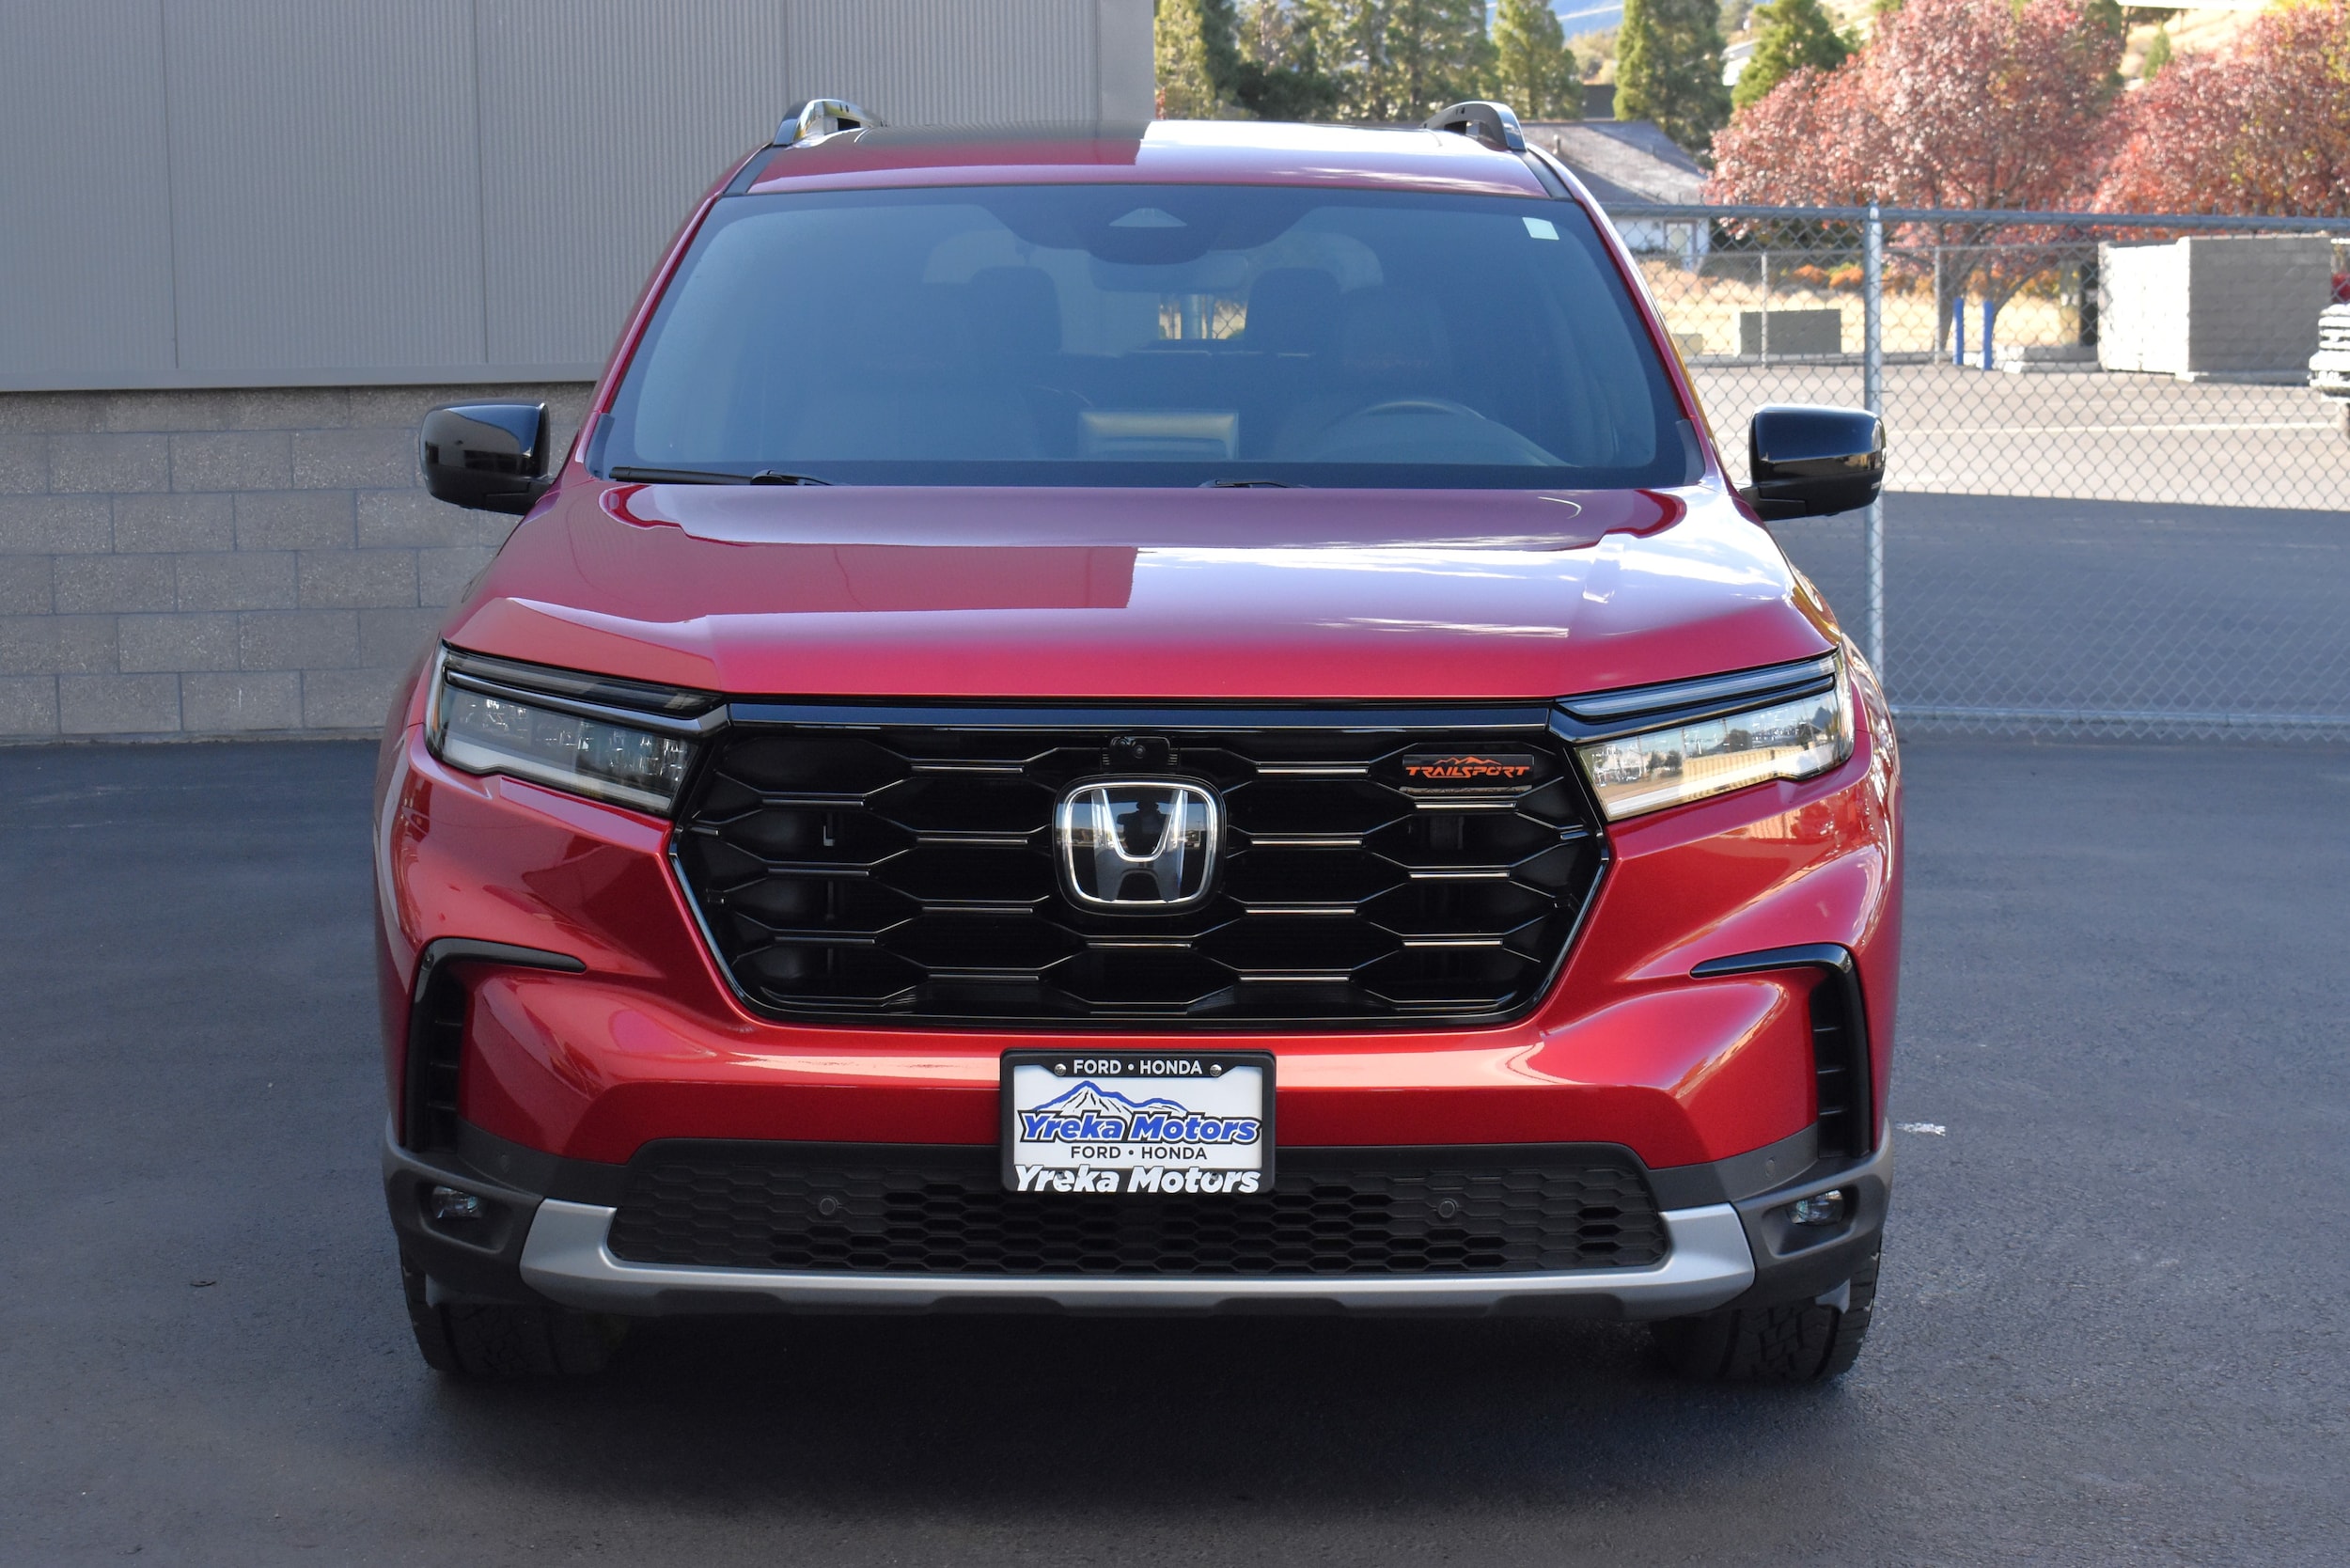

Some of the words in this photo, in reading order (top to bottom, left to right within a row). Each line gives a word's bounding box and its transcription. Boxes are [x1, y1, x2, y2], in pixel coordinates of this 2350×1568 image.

[1405, 766, 1530, 778] TRAILSPORT
[1073, 1059, 1121, 1074] FORD
[1139, 1059, 1202, 1074] HONDA
[1021, 1112, 1124, 1141] Yreka
[1130, 1112, 1261, 1142] Motors
[1071, 1146, 1121, 1160] FORD
[1141, 1146, 1208, 1160] HONDA
[1014, 1165, 1120, 1193] Yreka
[1127, 1166, 1261, 1194] Motors
